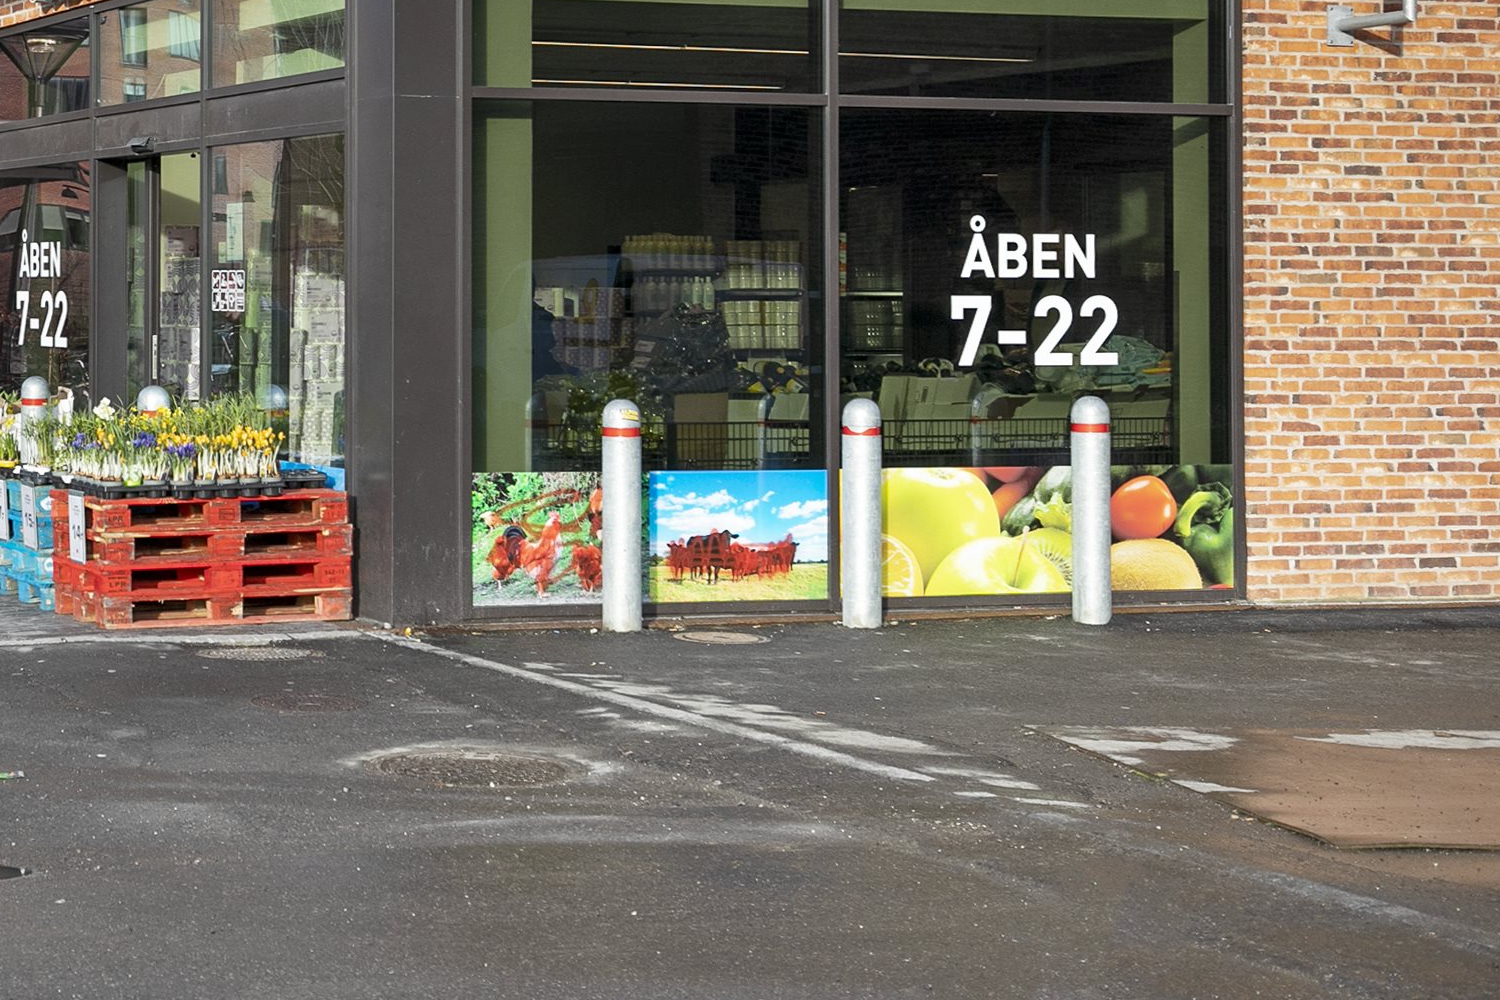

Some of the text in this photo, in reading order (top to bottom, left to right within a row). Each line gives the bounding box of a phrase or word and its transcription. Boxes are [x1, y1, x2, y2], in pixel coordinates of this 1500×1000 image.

[19, 228, 61, 278] ÅBEN
[960, 214, 1096, 279] ÅBEN
[15, 290, 68, 348] 7-22
[950, 294, 1119, 367] 7-22
